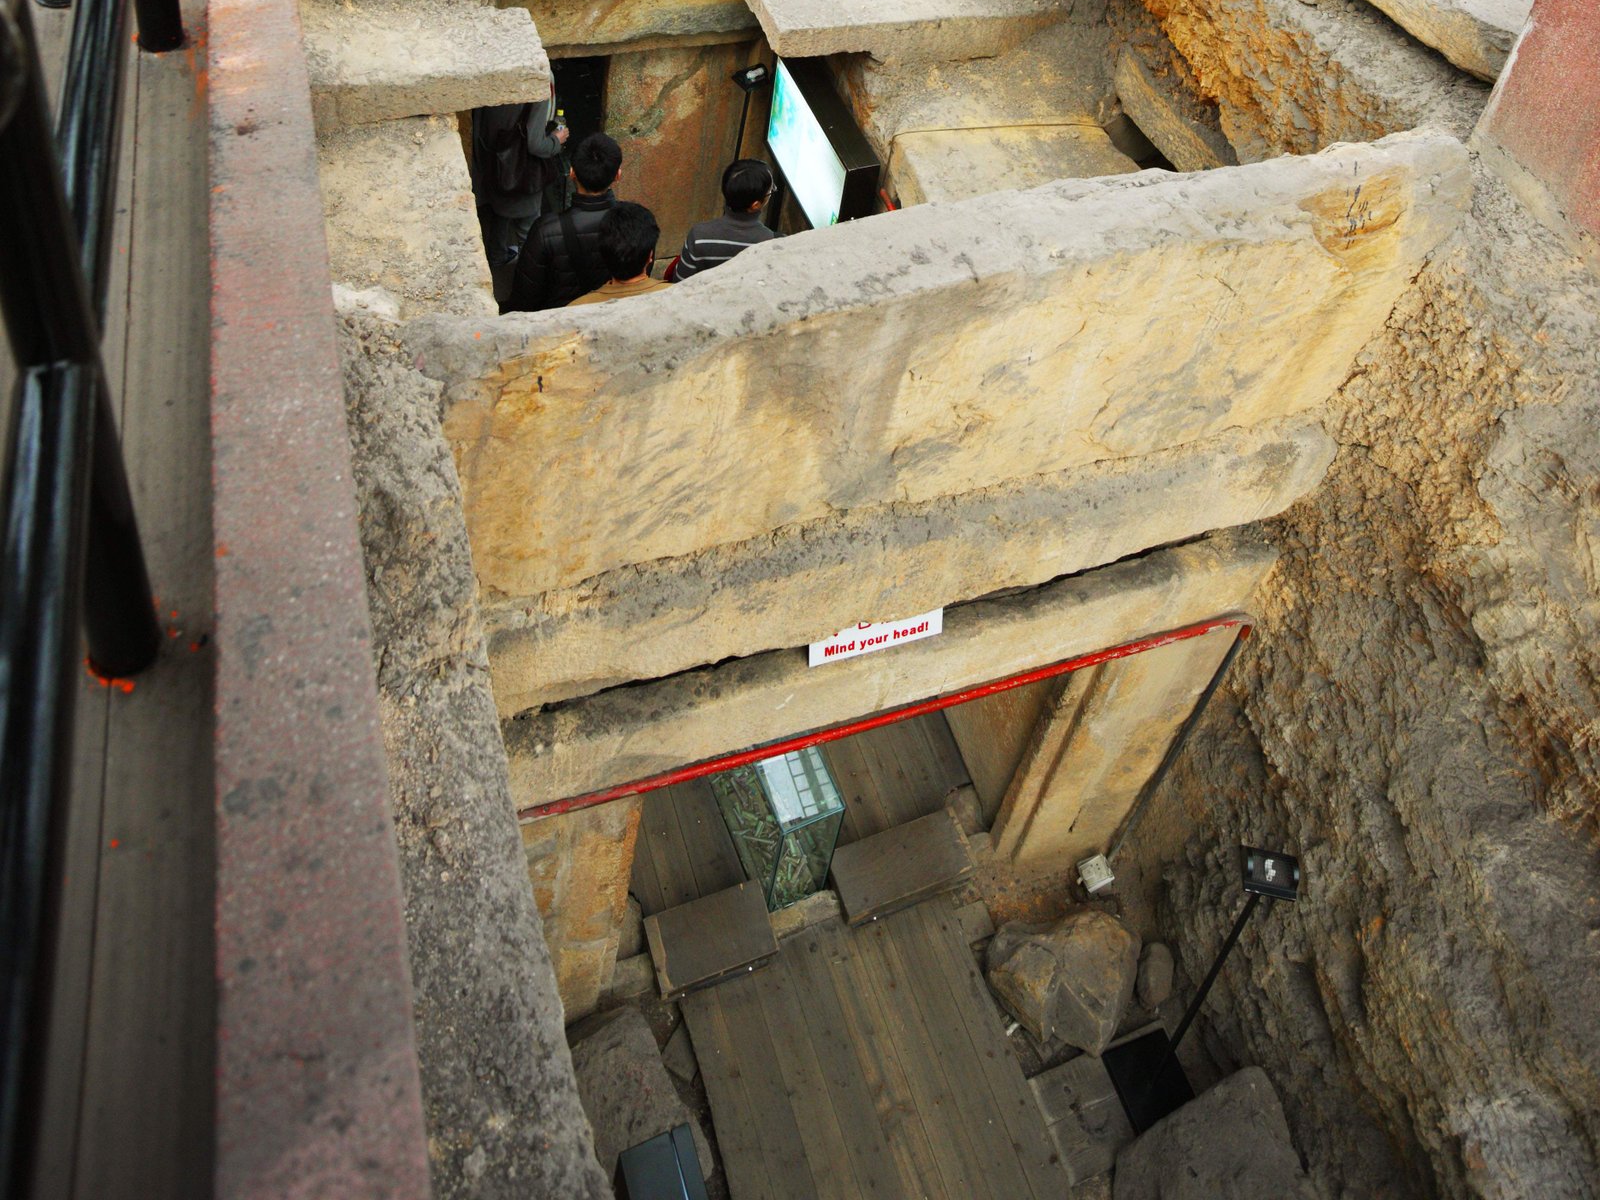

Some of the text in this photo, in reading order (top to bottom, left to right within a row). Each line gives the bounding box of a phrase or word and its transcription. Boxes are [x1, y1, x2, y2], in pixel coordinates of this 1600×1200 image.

[824, 641, 855, 657] Mind
[860, 634, 889, 650] your
[893, 621, 928, 639] head!
